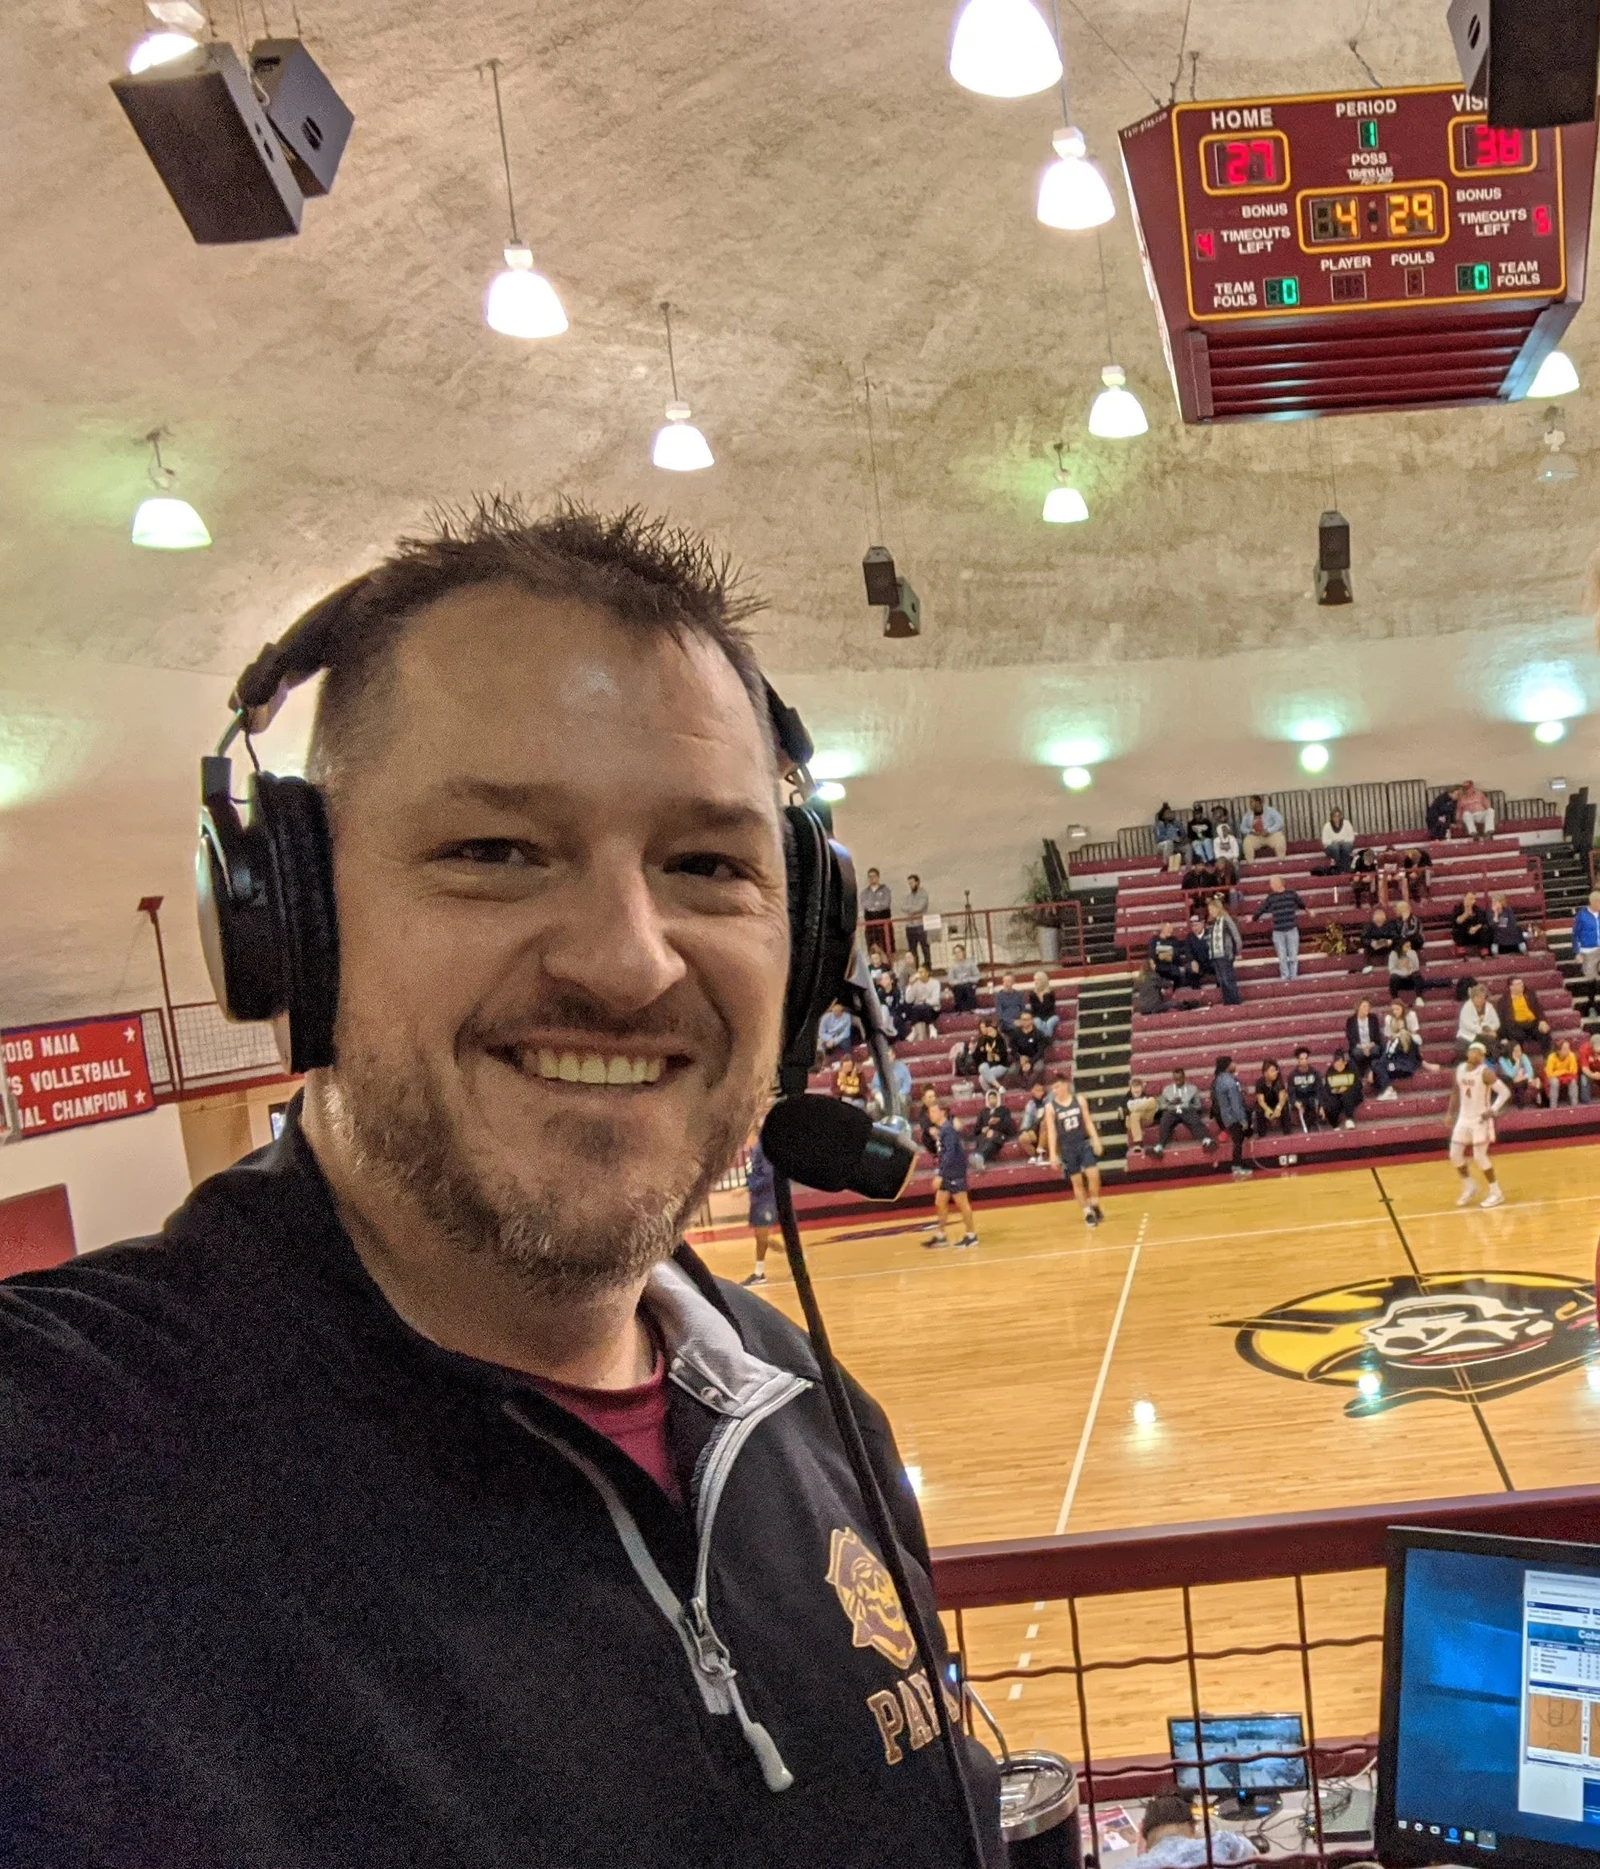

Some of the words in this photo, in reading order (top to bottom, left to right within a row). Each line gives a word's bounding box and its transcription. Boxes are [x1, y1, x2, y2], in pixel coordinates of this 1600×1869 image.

[1335, 98, 1398, 118] PERIOD
[1451, 94, 1488, 112] VISI
[1210, 107, 1274, 130] HOME
[1475, 124, 1522, 167] 38
[1226, 139, 1276, 186] 27
[1351, 152, 1388, 166] POSS
[1455, 187, 1502, 203] BONUS
[1241, 203, 1288, 219] BONUS
[1458, 208, 1528, 225] TIMEOUTS
[1220, 226, 1291, 243] TIMEOUTS
[1475, 221, 1510, 237] LEFT
[1197, 232, 1214, 258] 4
[1238, 241, 1274, 255] LEFT
[1320, 255, 1372, 272] PLAYER
[1391, 251, 1435, 266] FOULS
[1498, 260, 1538, 274] TEAM
[1474, 263, 1489, 291] 0
[1497, 273, 1541, 287] FOULS
[1214, 281, 1255, 296] TEAM
[1281, 278, 1298, 305] 0
[1213, 294, 1258, 308] FOULS
[40, 1033, 81, 1057] NAIA
[30, 1057, 132, 1093] VOLLEYBALL
[52, 1089, 129, 1122] CHAMPION
